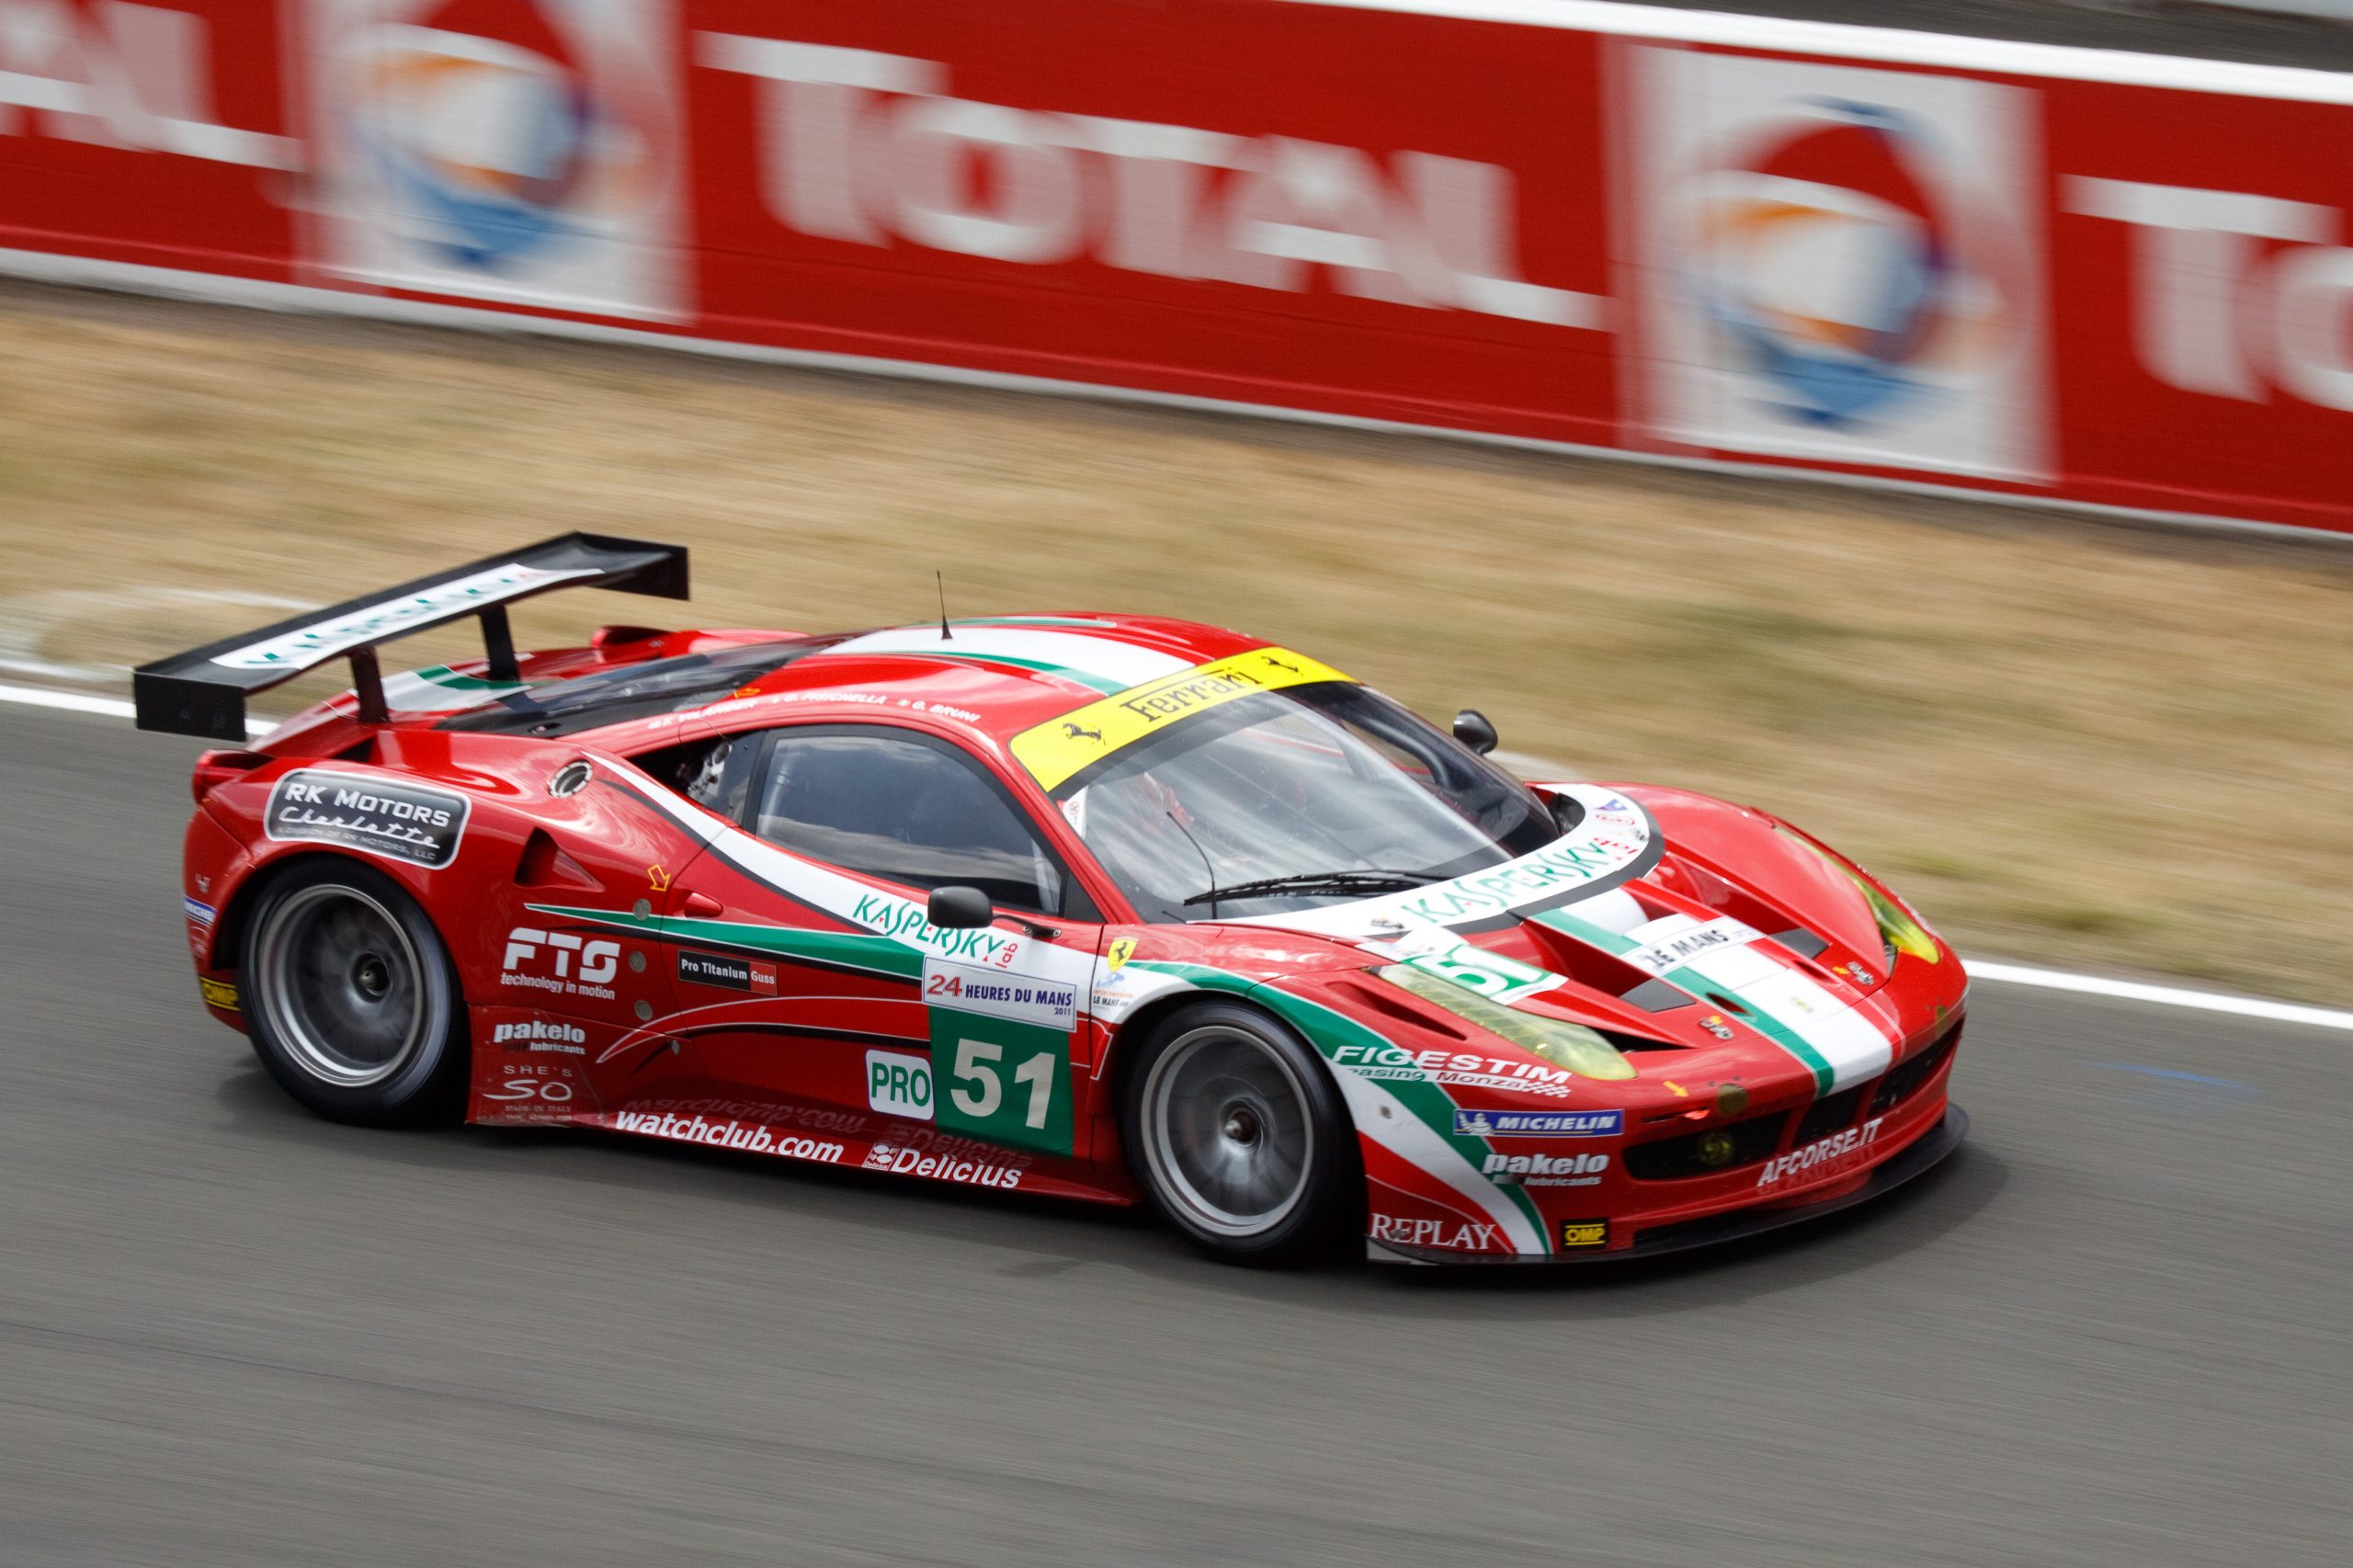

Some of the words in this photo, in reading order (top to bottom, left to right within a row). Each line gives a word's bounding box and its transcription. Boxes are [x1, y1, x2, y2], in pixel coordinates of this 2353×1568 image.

[694, 30, 1616, 333] TOTAL
[1120, 666, 1264, 722] Ferrari
[284, 782, 327, 804] RK
[333, 789, 451, 827] MOTORS
[414, 850, 438, 861] LLC
[1400, 841, 1608, 924] KASPERSKY
[503, 927, 621, 983] FTS
[680, 959, 699, 972] Pro
[701, 961, 748, 982] Titanium
[750, 970, 776, 985] Guss
[500, 972, 564, 994] technology
[566, 980, 577, 994] in
[578, 984, 616, 1001] motion
[926, 974, 963, 997] 24
[965, 984, 1011, 1002] HEURES
[1014, 989, 1033, 1004] DU
[1035, 990, 1074, 1007] MANS
[1054, 1006, 1072, 1017] 2011
[493, 1020, 586, 1043] pakelo
[529, 1041, 586, 1055] lubricants
[1333, 1045, 1573, 1085] FIGESTIM
[1437, 1071, 1525, 1090] Monza
[870, 1062, 931, 1108] PRO
[949, 1038, 1057, 1131] 51
[614, 1110, 845, 1164] watchclub.com
[1495, 1115, 1618, 1131] MICHELIN
[890, 1148, 1023, 1189] Delicius
[1482, 1153, 1609, 1176] pakelo
[1756, 1118, 1884, 1188] AFCORSE.IT
[1523, 1176, 1603, 1187] lubricants
[1370, 1213, 1496, 1251] REPLAY
[1564, 1227, 1605, 1244] OMP
